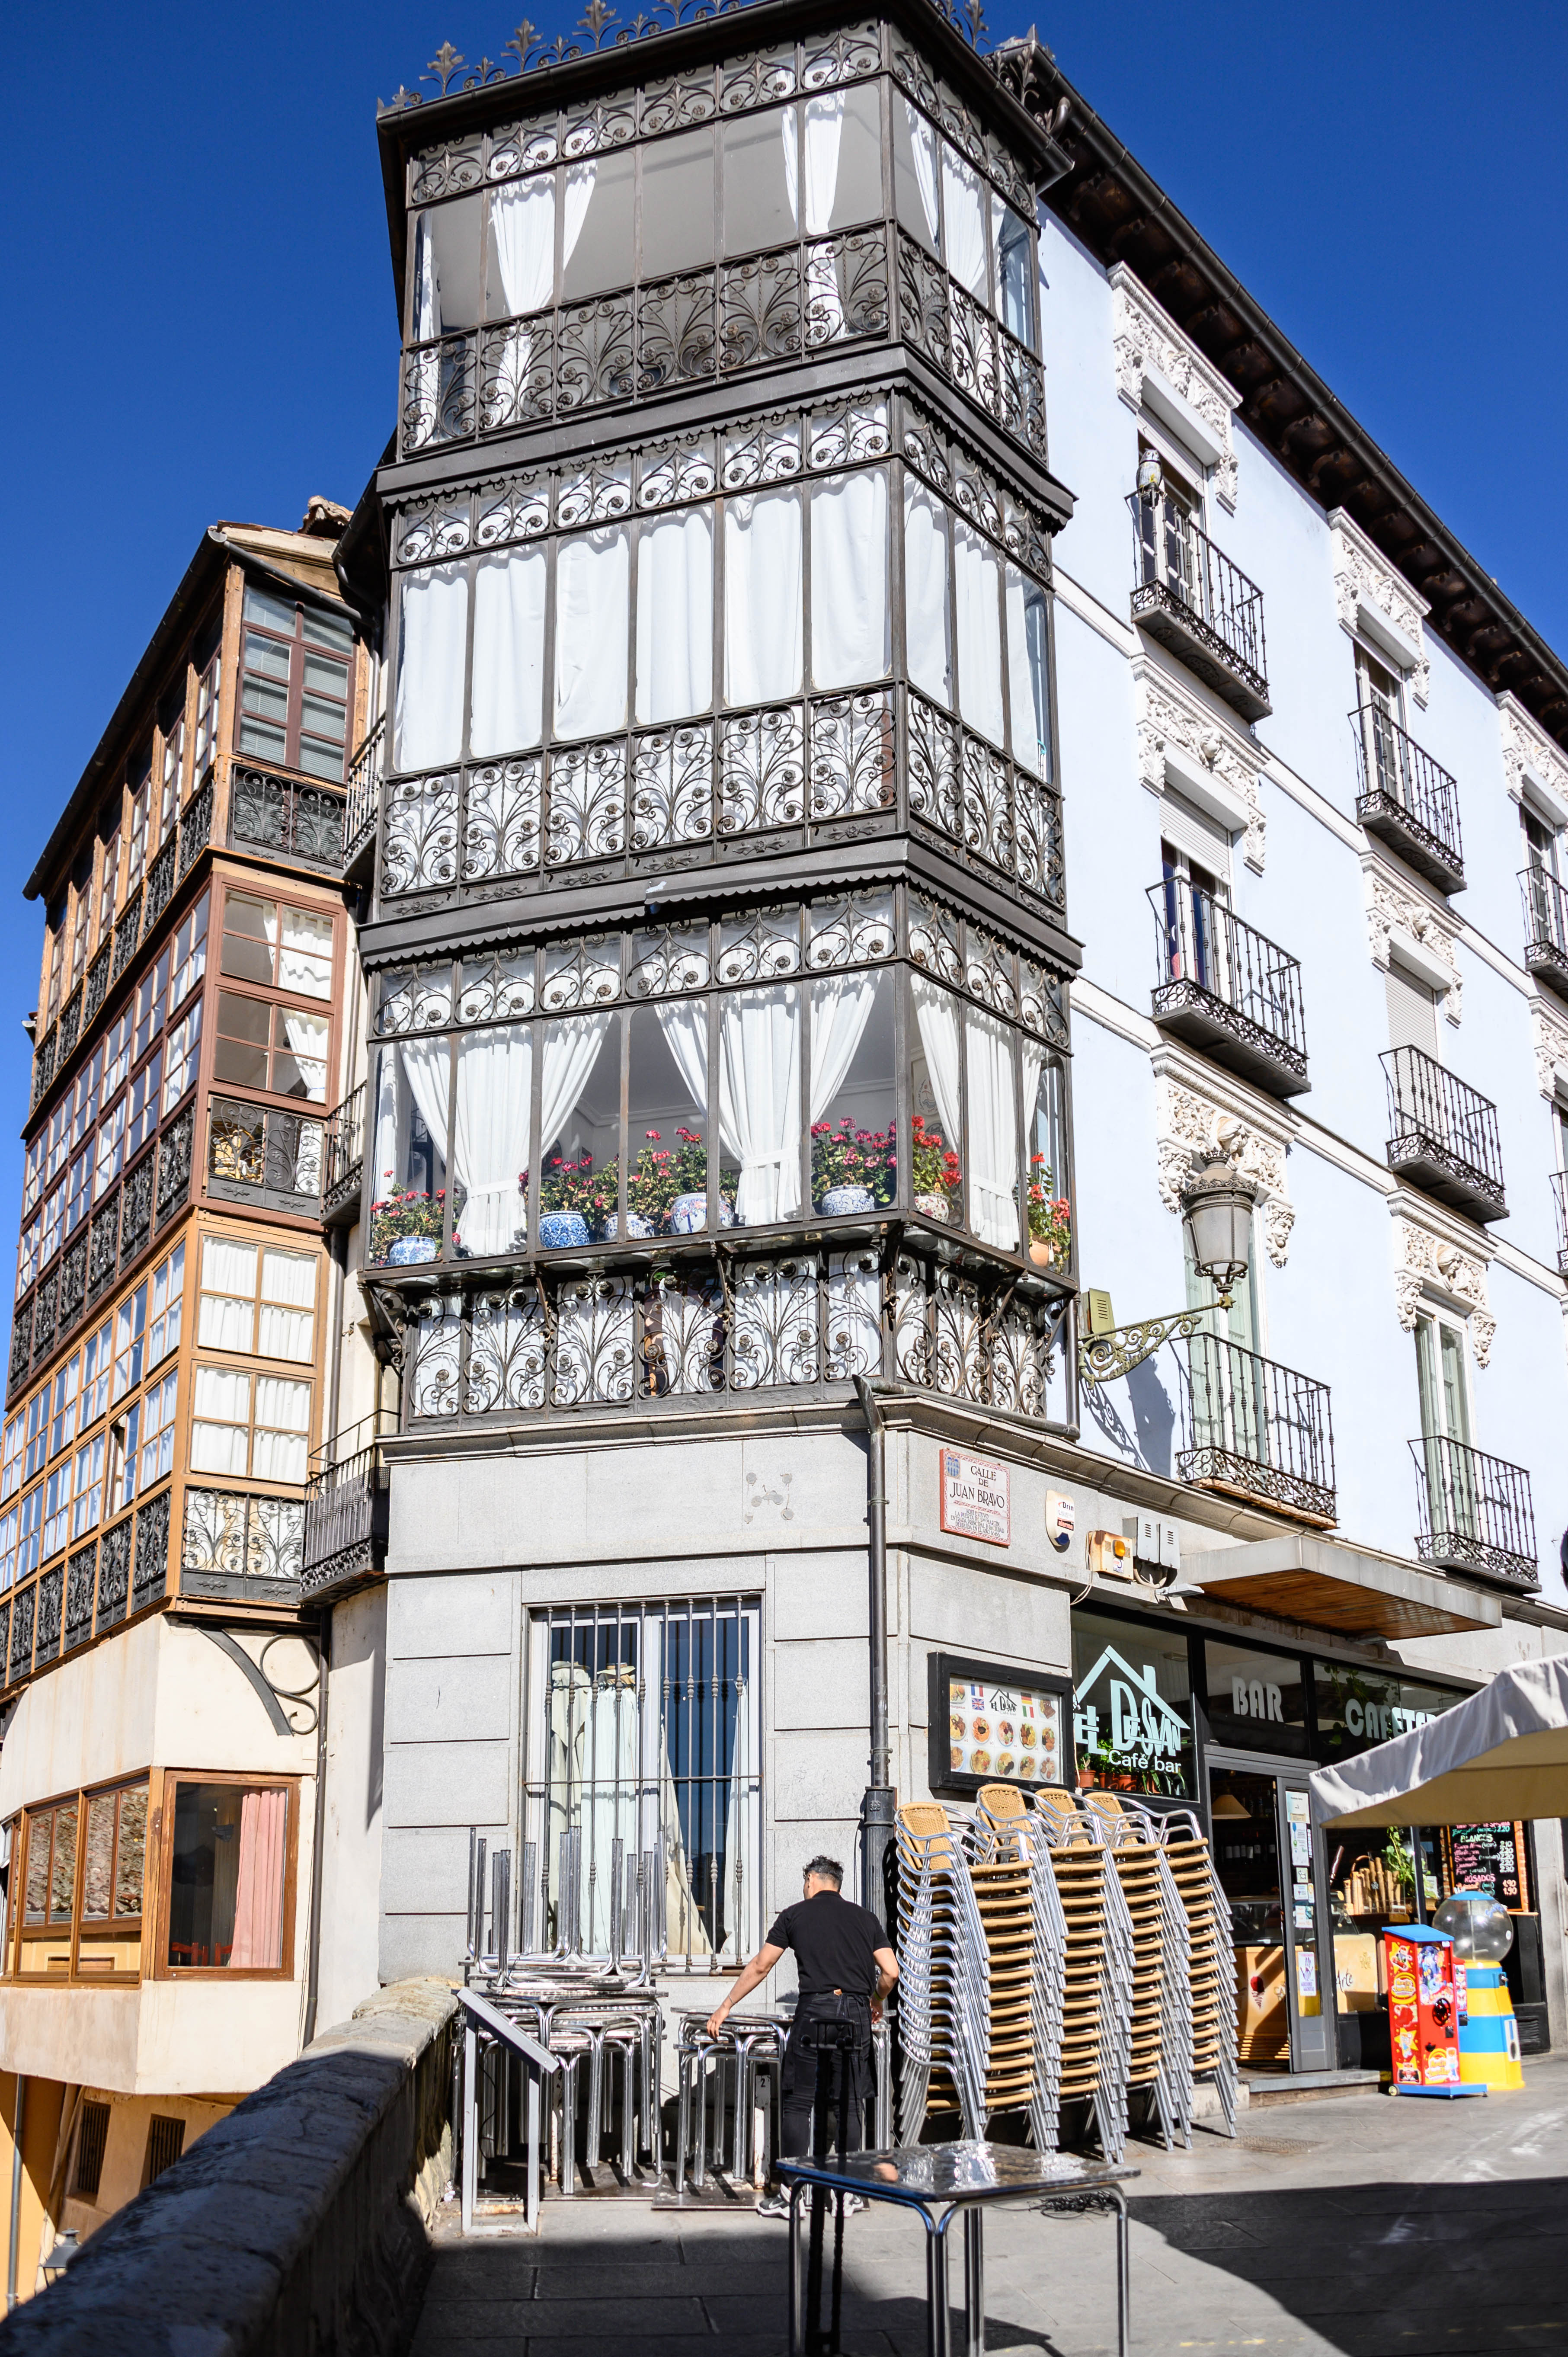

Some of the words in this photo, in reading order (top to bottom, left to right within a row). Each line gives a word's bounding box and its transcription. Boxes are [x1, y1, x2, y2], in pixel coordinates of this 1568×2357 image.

[970, 1466, 996, 1481] CALLE
[979, 1478, 989, 1487] DE
[950, 1482, 975, 1500] JUAN
[978, 1489, 1005, 1508] BRAVO
[1062, 1502, 1074, 1511] Drin
[950, 1515, 966, 1523] ENTRADA
[1232, 1675, 1284, 1723] BAR
[1073, 1705, 1107, 1755] EL
[1108, 1750, 1148, 1769] Café
[1154, 1756, 1181, 1773] bar
[1460, 1833, 1493, 1843] BLANCOS
[1464, 1873, 1496, 1883] ROSADOS
[761, 2078, 766, 2088] 2
